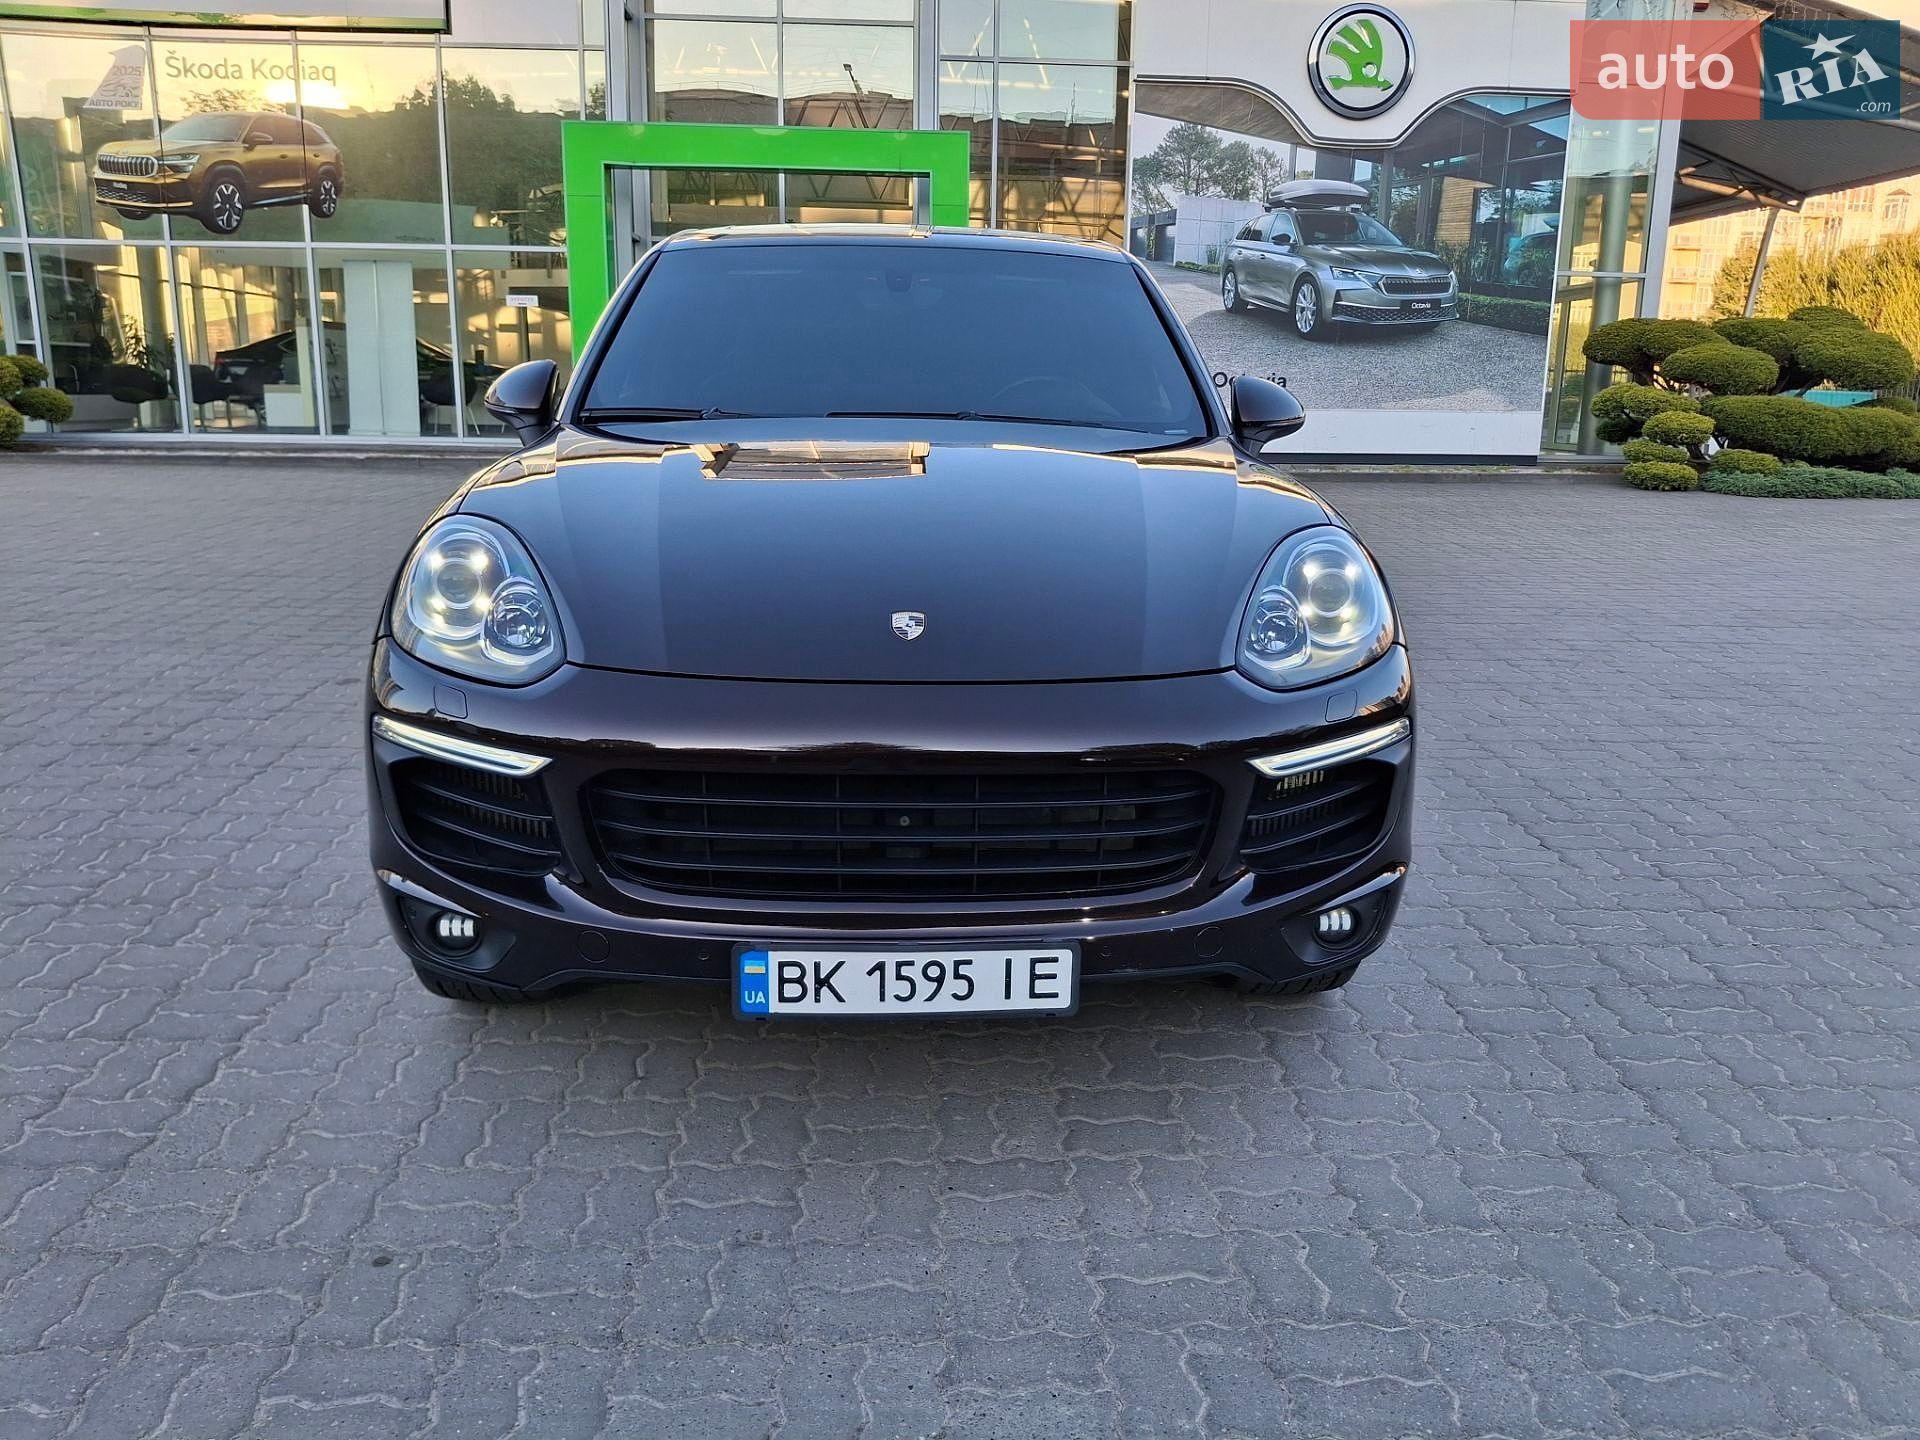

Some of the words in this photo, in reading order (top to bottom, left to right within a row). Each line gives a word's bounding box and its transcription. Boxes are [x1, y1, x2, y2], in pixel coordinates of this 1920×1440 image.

[111, 65, 142, 77] 2025
[165, 50, 244, 80] Škoda
[251, 59, 336, 86] Kodiaq
[777, 960, 846, 1003] BK
[866, 959, 975, 1003] 1595
[1004, 956, 1060, 1000] IE
[745, 991, 766, 1004] UA
